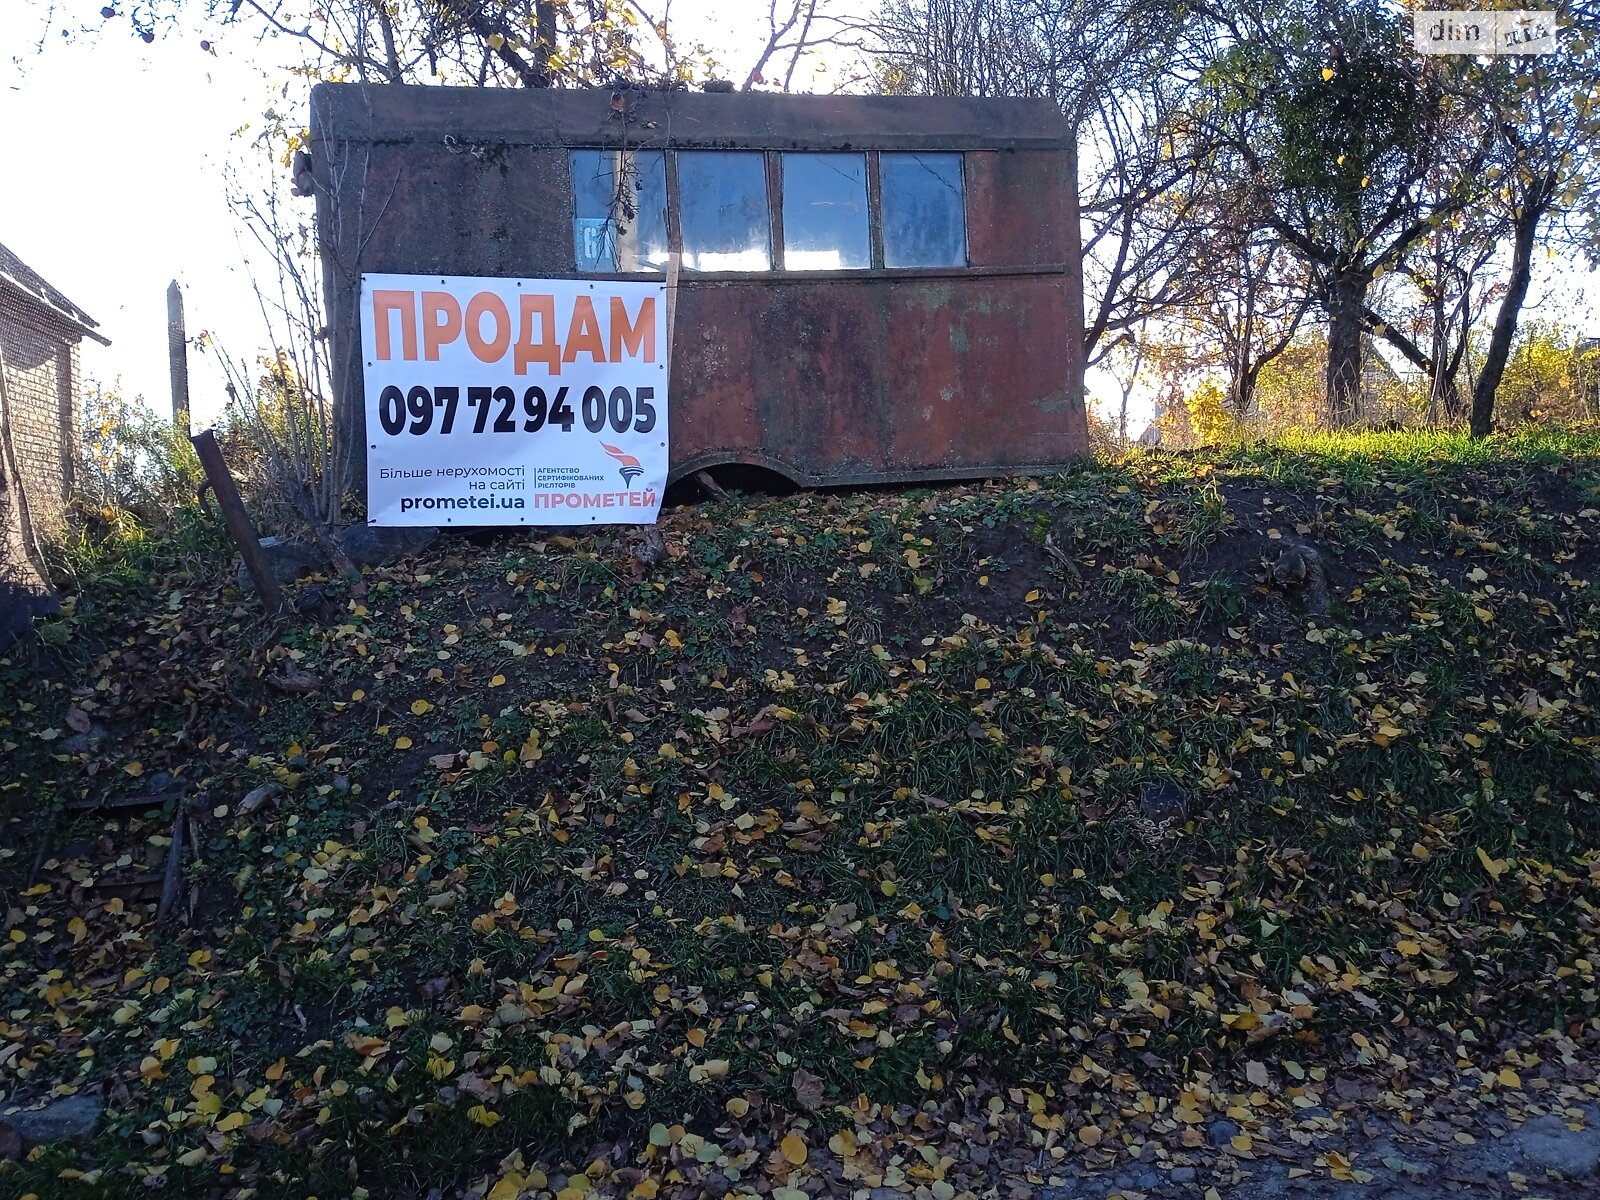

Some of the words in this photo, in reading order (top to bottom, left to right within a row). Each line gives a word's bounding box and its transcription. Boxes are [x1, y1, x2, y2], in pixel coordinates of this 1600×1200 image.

[372, 289, 656, 376] ПРОДАМ
[378, 385, 460, 436] 097
[467, 386, 516, 434] 72
[523, 386, 575, 433] 94
[581, 385, 657, 434] 005
[380, 467, 433, 480] Більше
[437, 465, 526, 481] нерухомості
[537, 474, 605, 482] СЕРТИФІКОВАНИХ
[469, 481, 486, 491] на
[489, 478, 526, 491] сайті
[400, 493, 525, 512] prometei.ua
[534, 487, 656, 510] ПРОМЕТЕЙ
